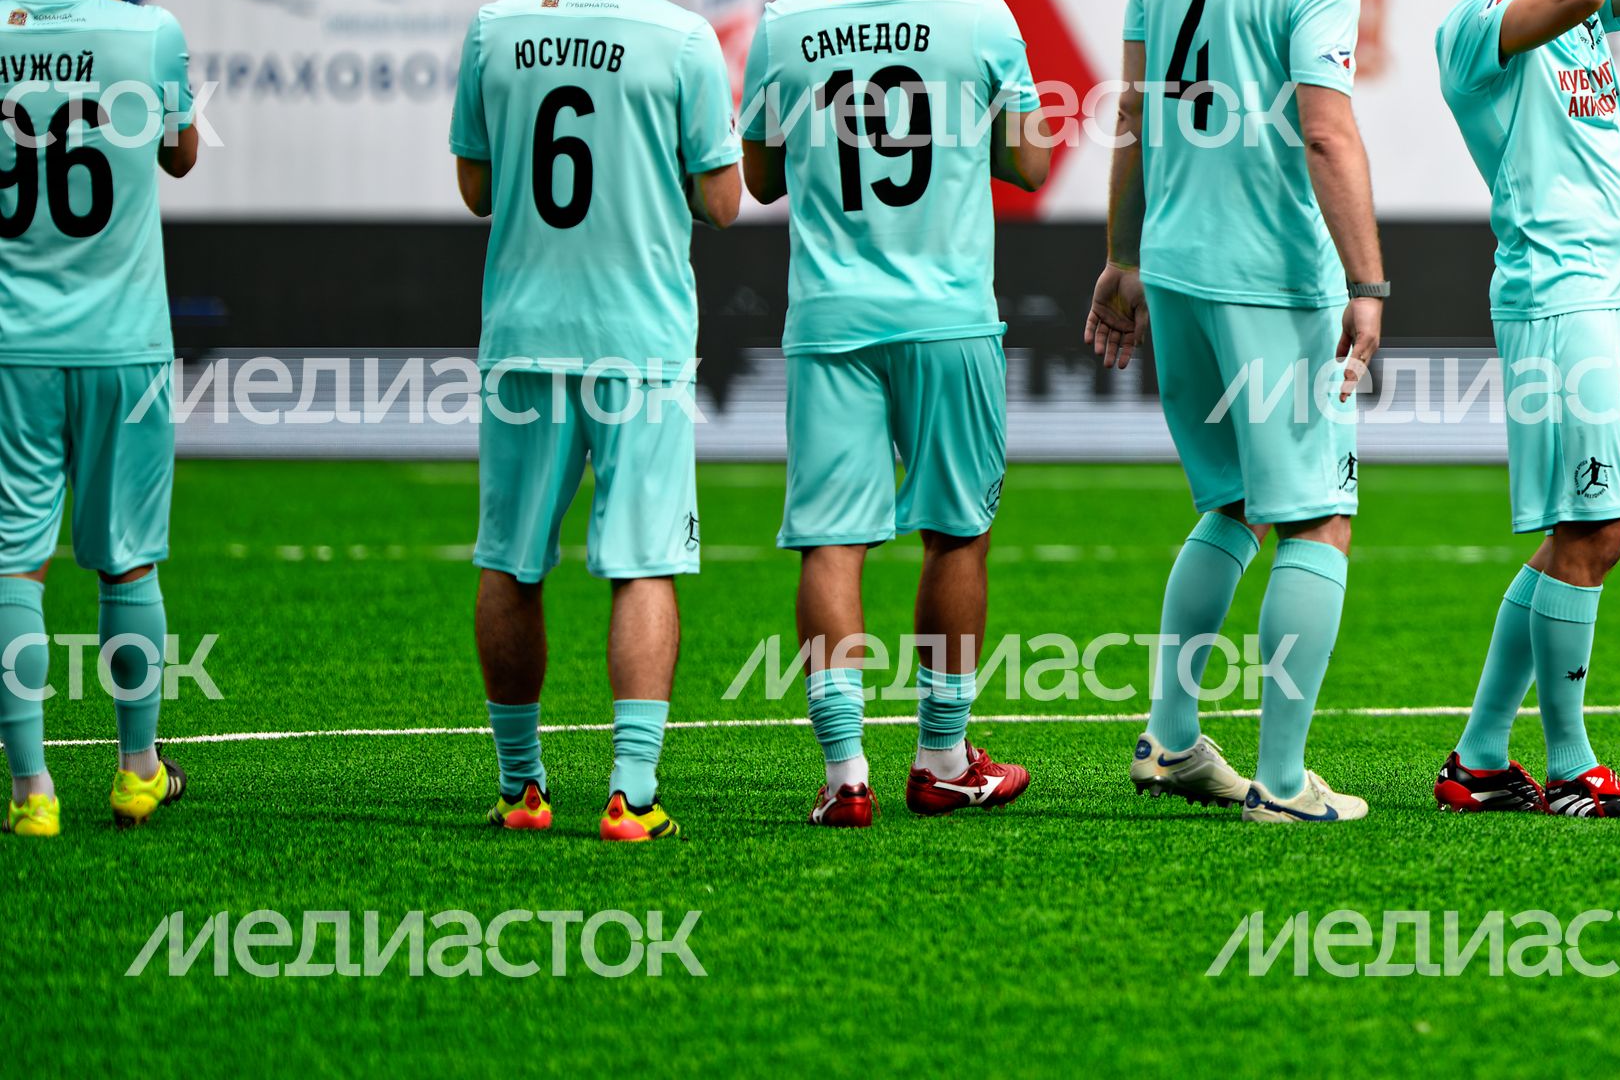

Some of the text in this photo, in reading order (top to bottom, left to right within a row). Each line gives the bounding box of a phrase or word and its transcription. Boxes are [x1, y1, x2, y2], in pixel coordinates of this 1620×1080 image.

[515, 37, 625, 72] ЮСУПОВ
[801, 22, 930, 62] САМЕДОВ
[188, 52, 462, 103] ТРАХОВО
[532, 85, 595, 229] 6
[815, 64, 933, 213] 19
